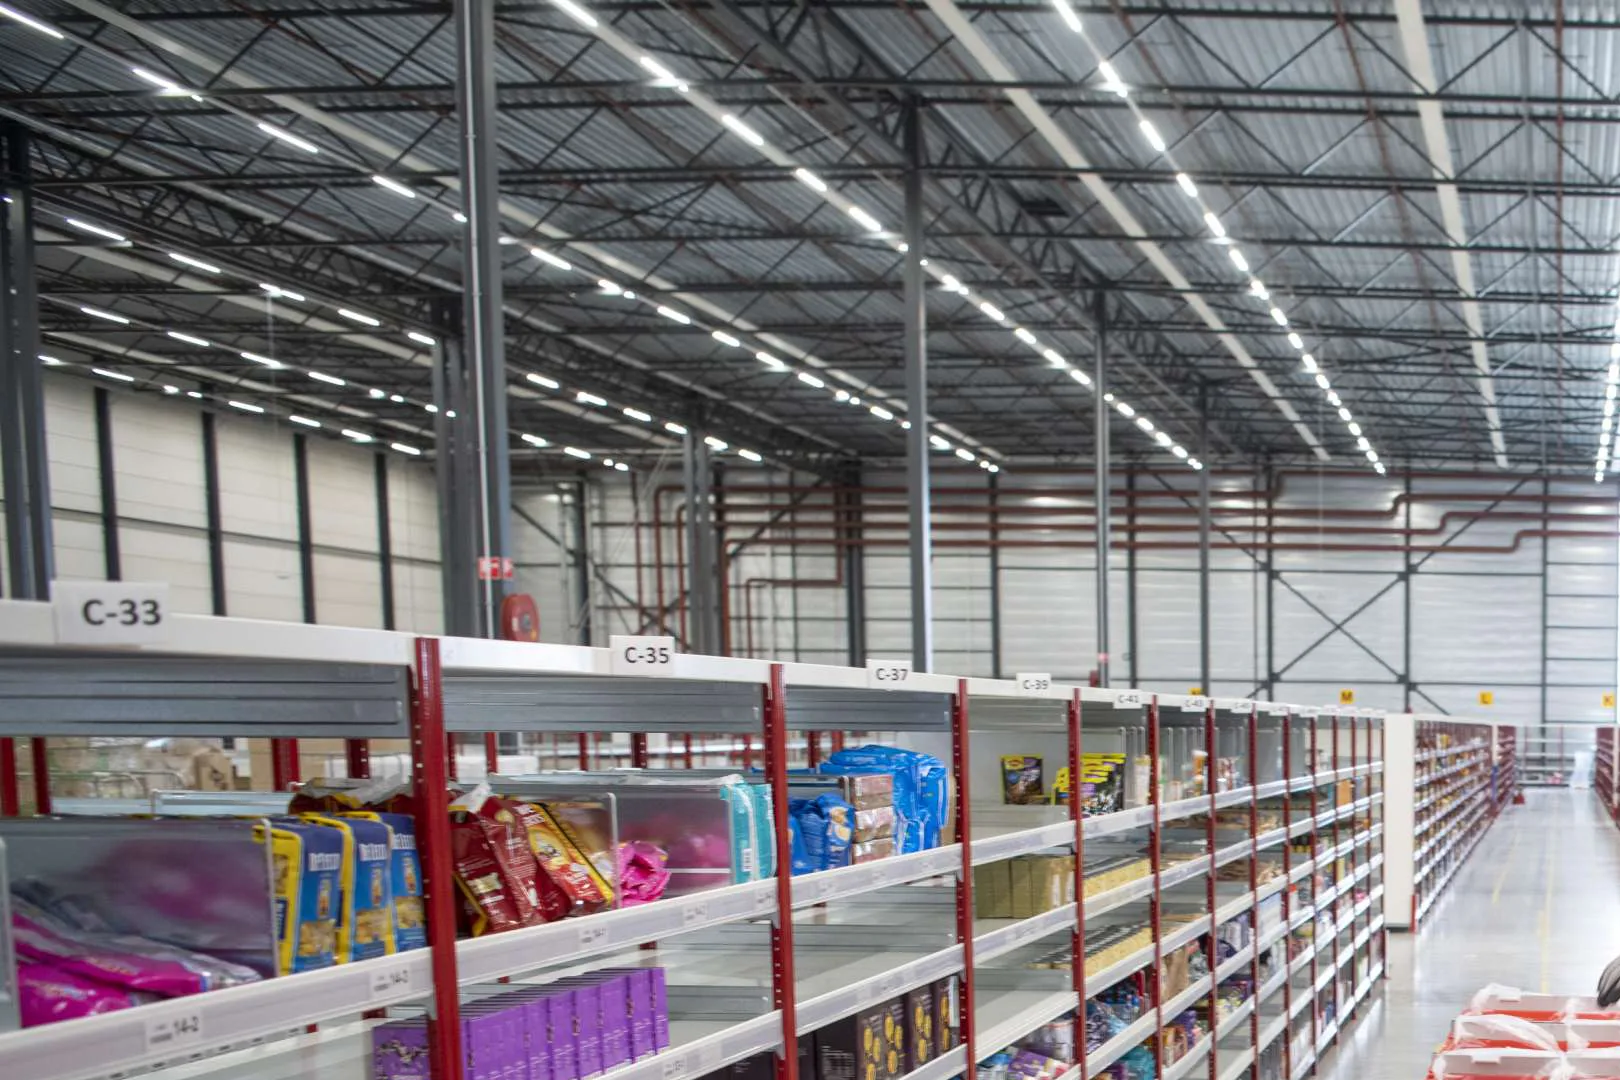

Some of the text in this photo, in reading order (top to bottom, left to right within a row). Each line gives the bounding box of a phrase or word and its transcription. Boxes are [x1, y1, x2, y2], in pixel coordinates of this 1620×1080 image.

[83, 599, 162, 627] C-33
[624, 647, 669, 665] C-35
[876, 668, 908, 681] C-37
[1023, 679, 1048, 690] C-39
